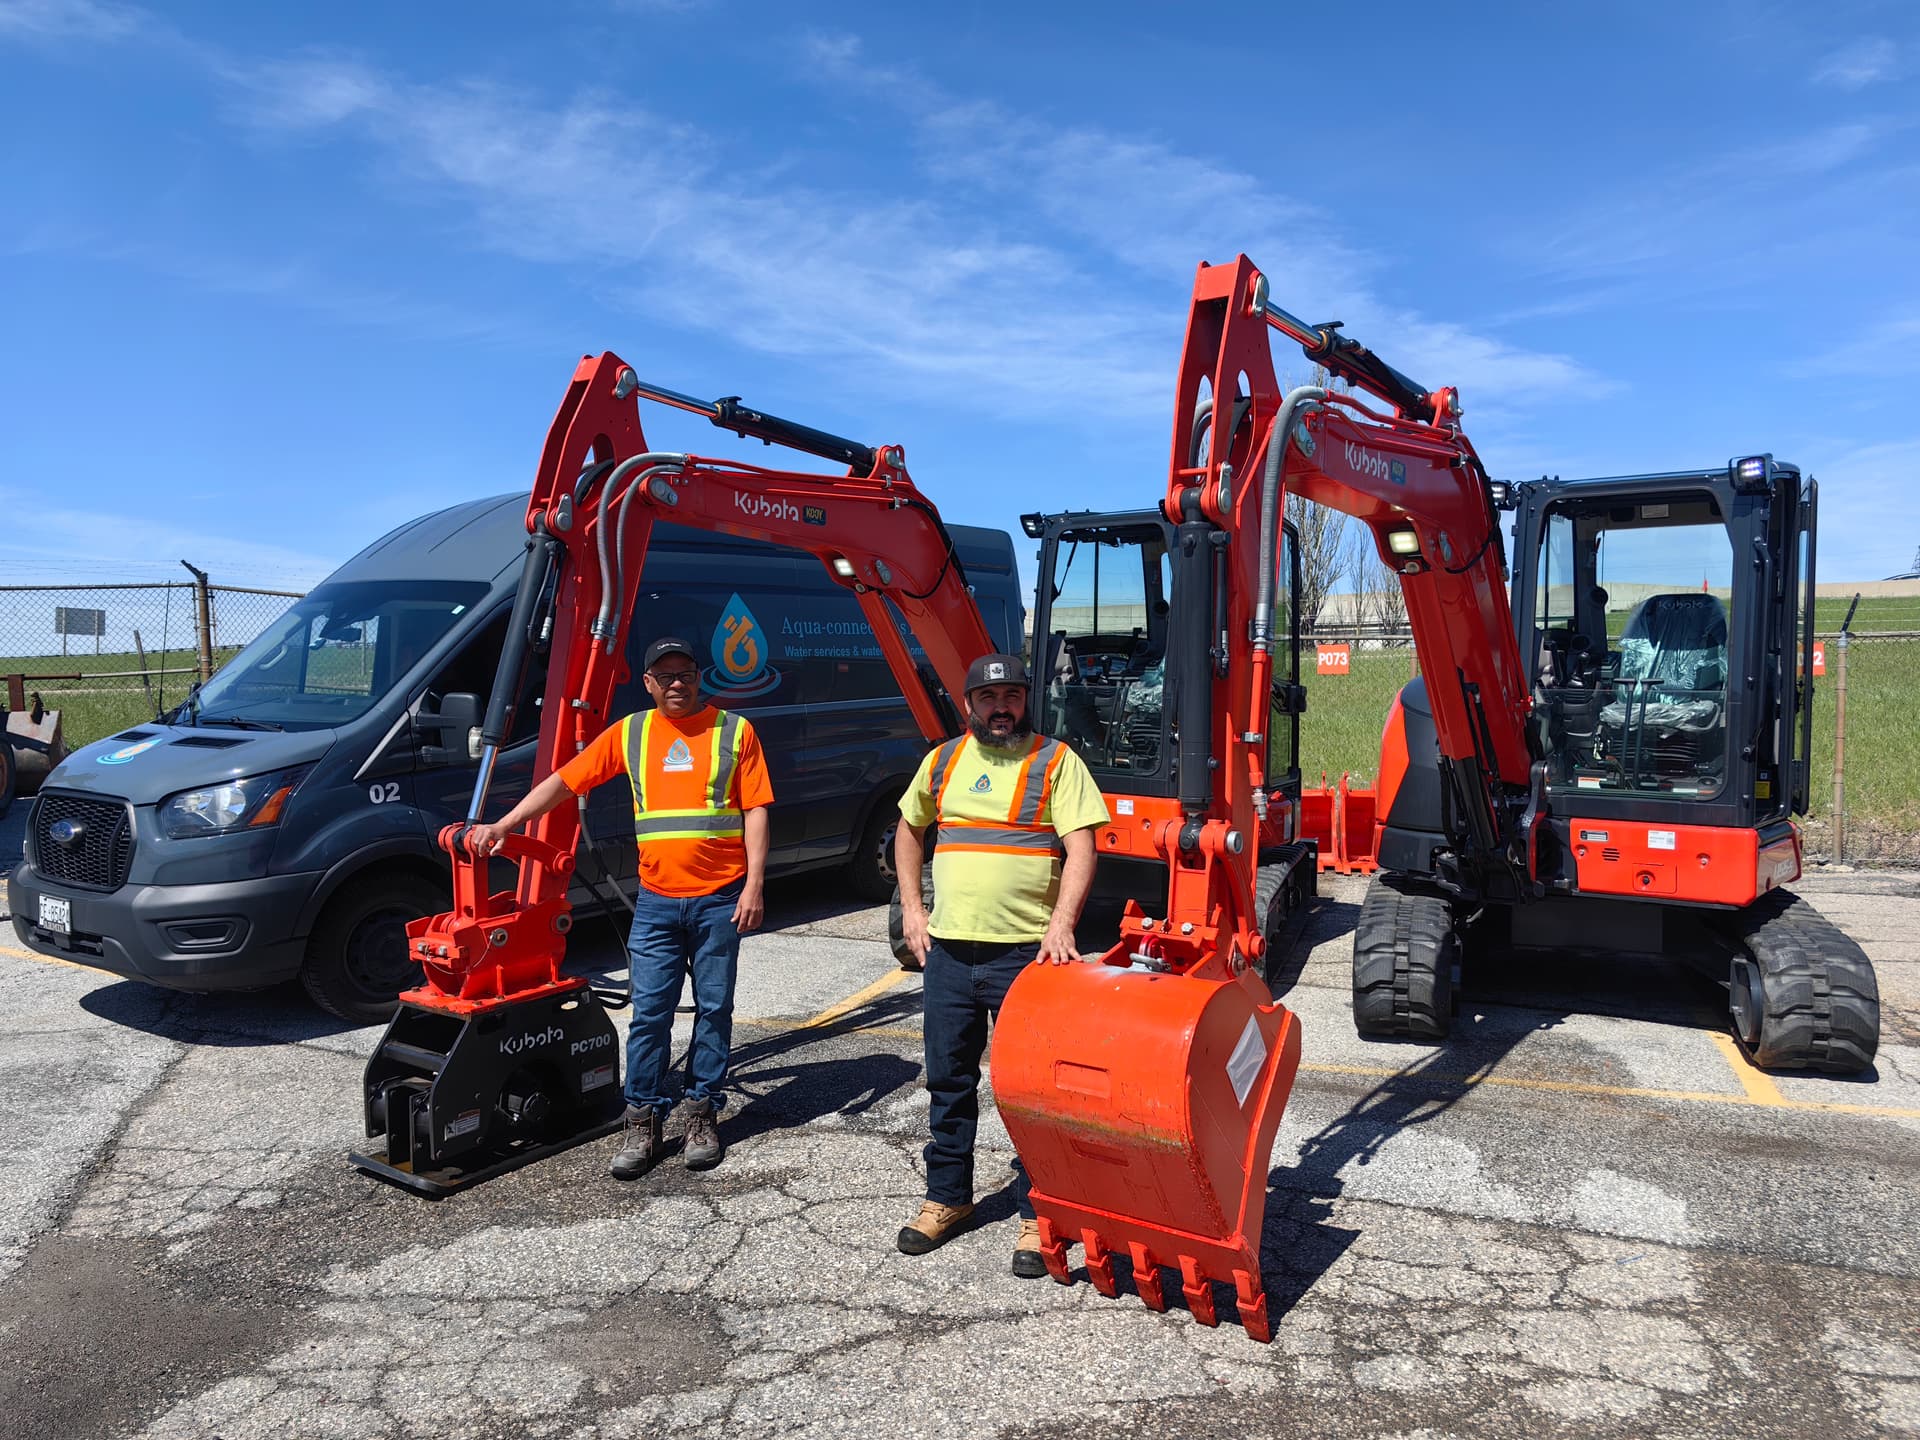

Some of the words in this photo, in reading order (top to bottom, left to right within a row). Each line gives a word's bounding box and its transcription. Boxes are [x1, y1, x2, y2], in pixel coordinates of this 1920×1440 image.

[1345, 440, 1389, 481] Kubota
[735, 491, 799, 521] Kubota
[781, 616, 907, 638] Aqua-connecs
[784, 645, 811, 657] Water
[813, 645, 851, 657] services
[853, 645, 860, 657] &
[1318, 652, 1348, 666] P073
[369, 782, 401, 804] 02
[499, 1026, 564, 1055] Kubota
[571, 1033, 611, 1056] PC700
